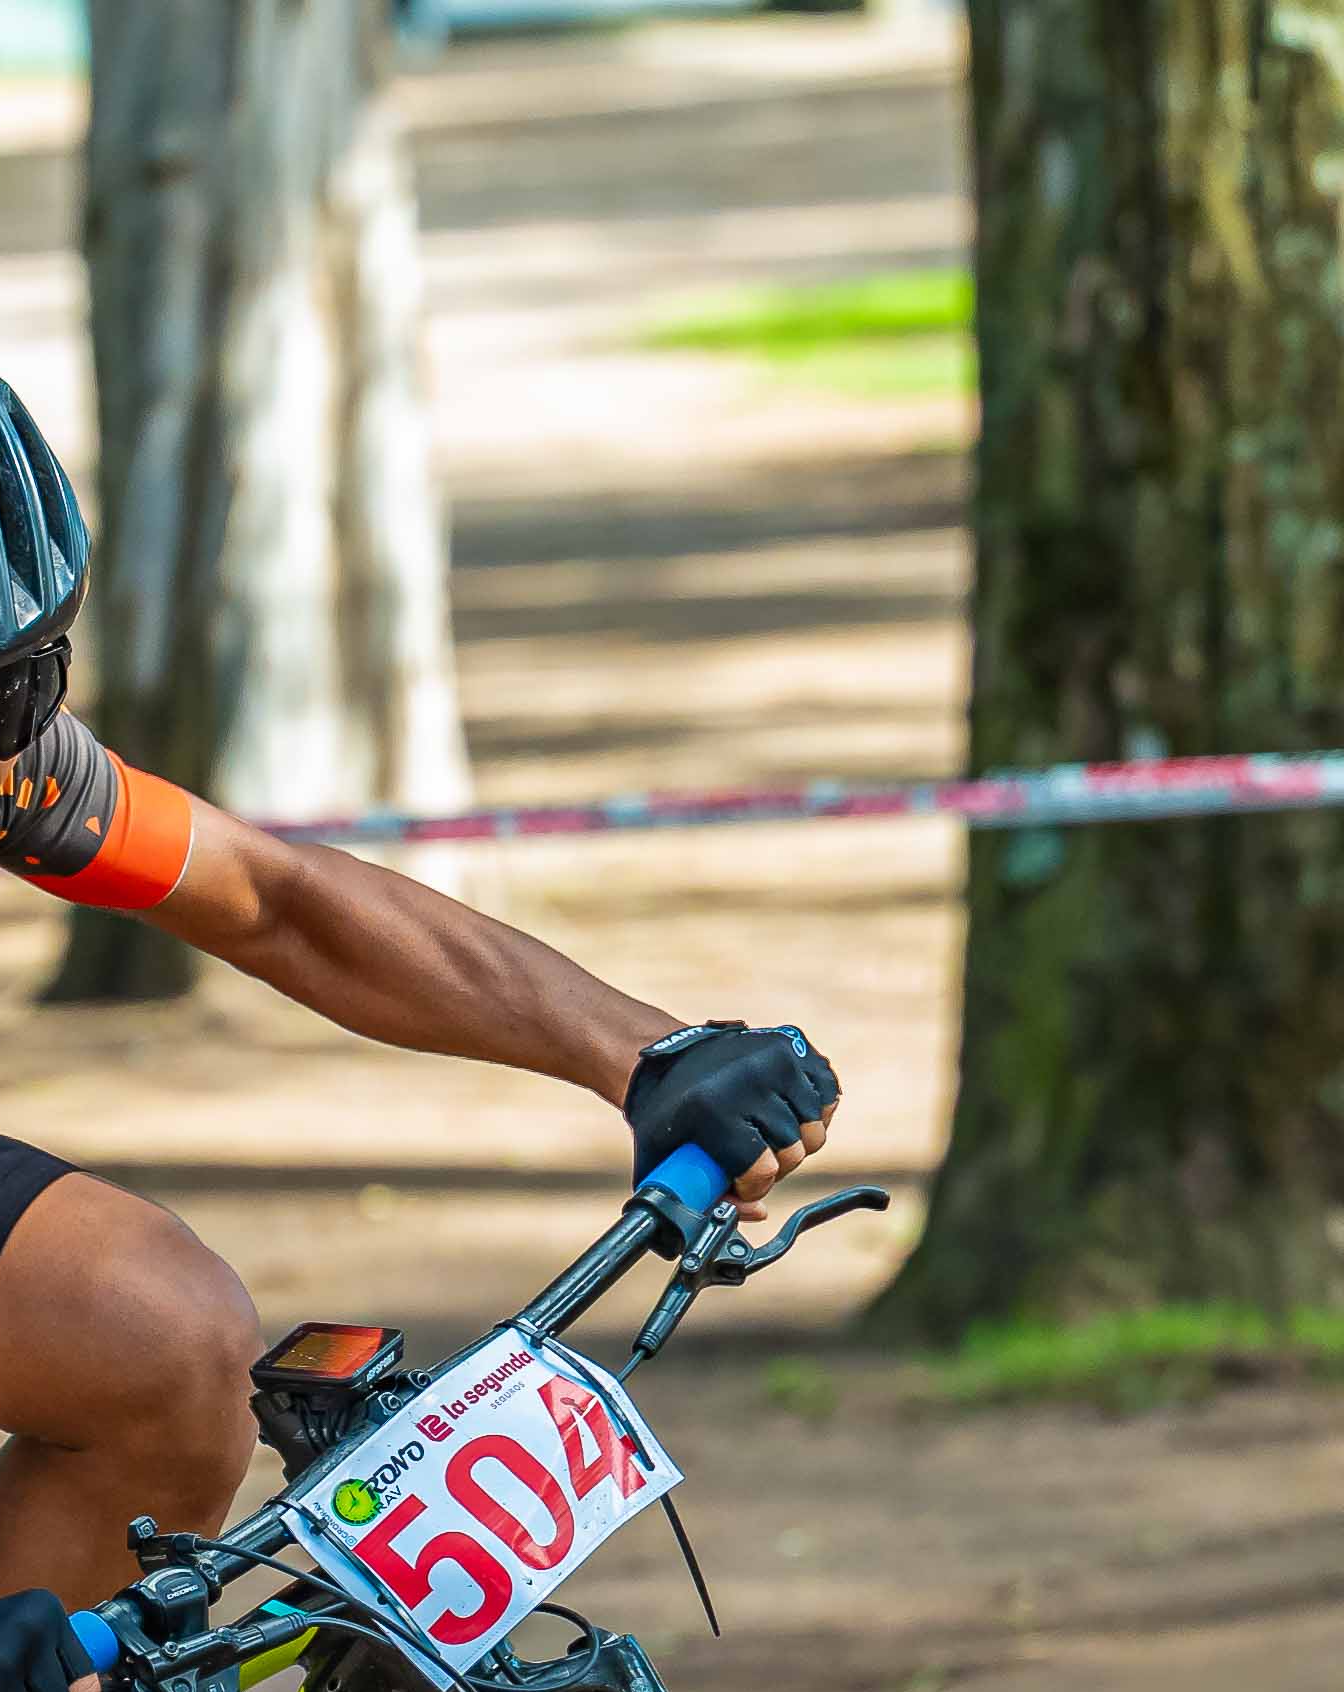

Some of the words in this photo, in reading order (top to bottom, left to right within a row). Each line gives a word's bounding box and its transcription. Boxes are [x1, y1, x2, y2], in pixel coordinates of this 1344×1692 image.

[652, 1026, 704, 1051] GIANT
[440, 1400, 470, 1421] la
[463, 1350, 536, 1404] segunda
[352, 1374, 647, 1646] 504
[373, 1485, 403, 1515] RAV
